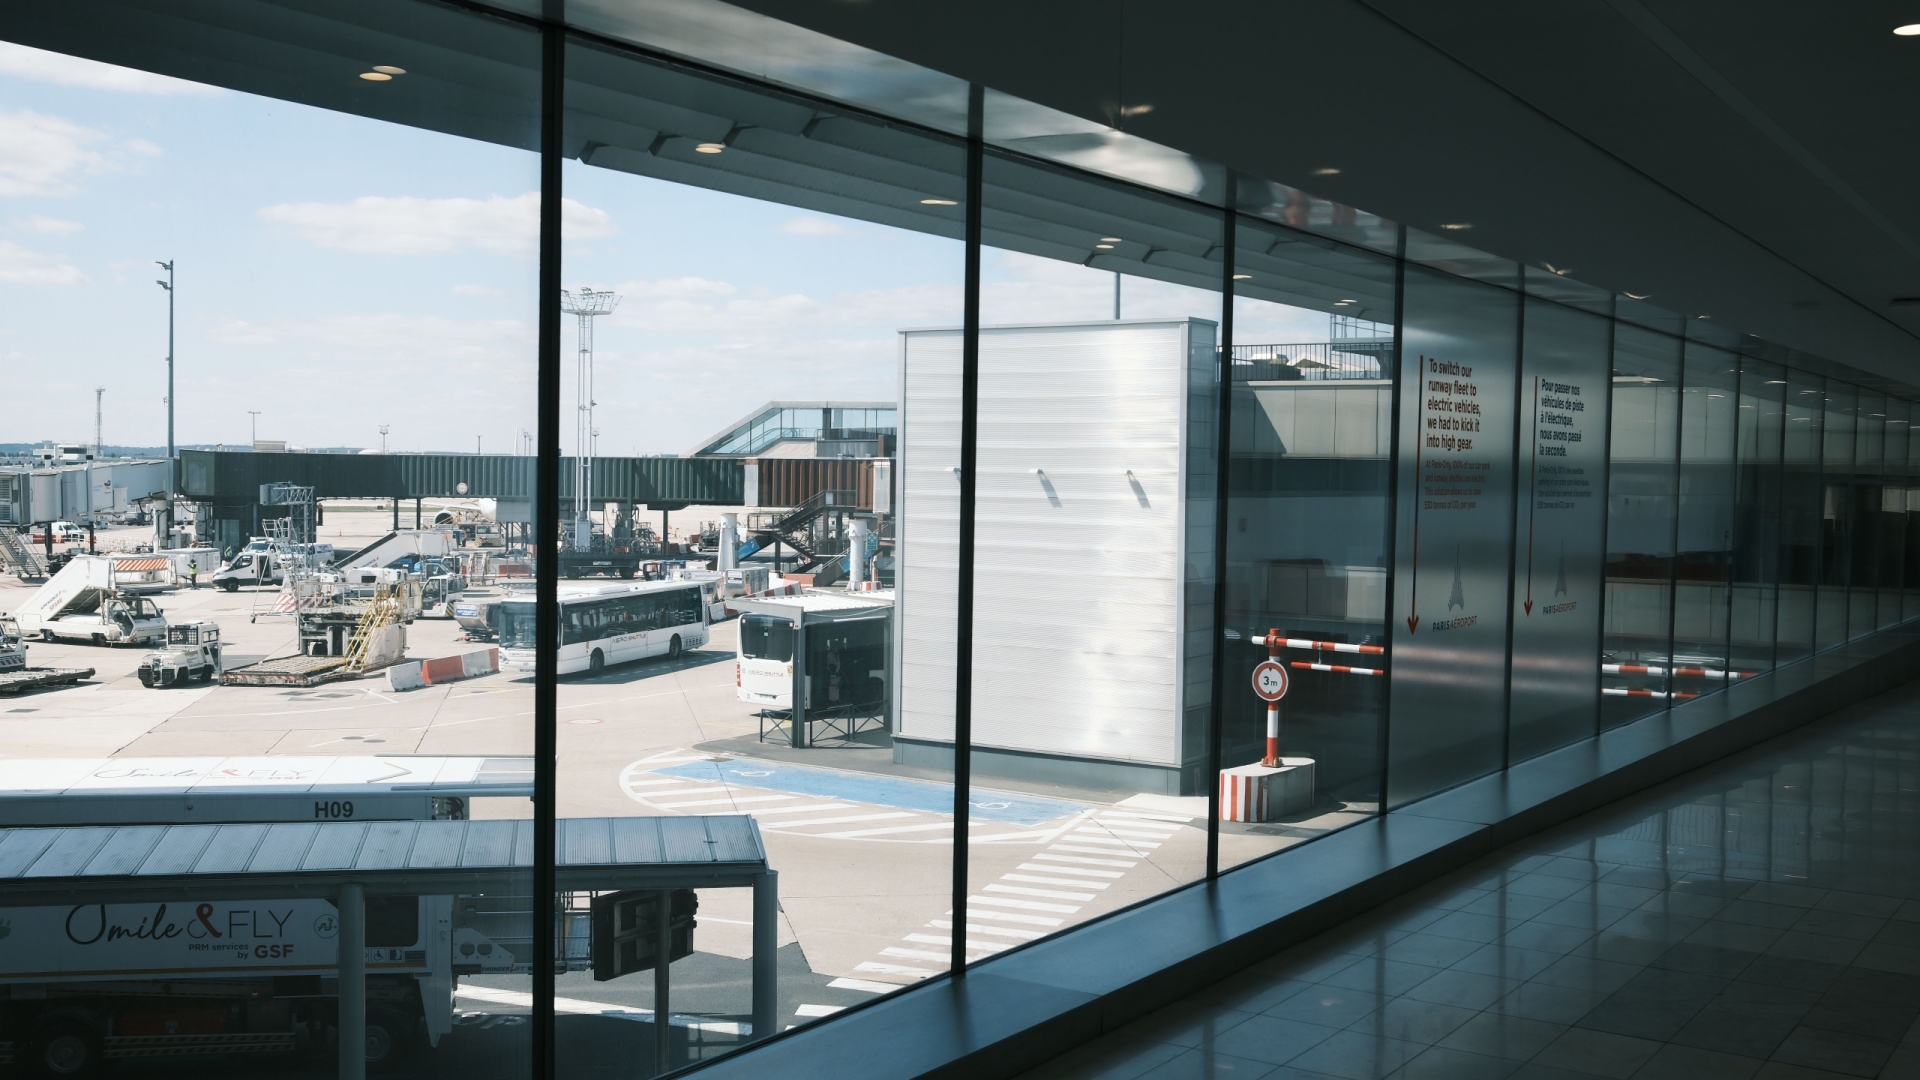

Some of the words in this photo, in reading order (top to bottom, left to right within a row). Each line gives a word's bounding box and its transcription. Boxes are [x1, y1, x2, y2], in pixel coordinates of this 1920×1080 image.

[1429, 358, 1438, 373] To
[1439, 360, 1460, 376] switch
[1461, 366, 1472, 378] our
[1428, 380, 1452, 396] runway
[1454, 380, 1468, 396] fleet
[1470, 383, 1476, 396] to
[1542, 378, 1554, 392] Pour
[1555, 383, 1570, 395] passer
[1571, 386, 1580, 396] nos
[1428, 396, 1452, 412] electric
[1454, 399, 1480, 417] vehicles,
[1541, 394, 1564, 409] véhicules
[1565, 398, 1571, 410] de
[1572, 399, 1584, 413] piste
[1427, 417, 1437, 429] we
[1438, 415, 1451, 430] had
[1452, 417, 1459, 431] to
[1461, 417, 1474, 432] kick
[1475, 418, 1480, 432] it
[1540, 410, 1544, 423] à
[1426, 433, 1440, 448] into
[1441, 434, 1455, 451] high
[1457, 437, 1472, 452] gear.
[1540, 430, 1552, 440] nous
[1553, 430, 1567, 441] avons
[1568, 430, 1582, 444] passé
[1539, 443, 1544, 456] la
[1545, 445, 1567, 457] seconde.
[1482, 462, 1490, 471] park
[315, 801, 354, 818] H09
[188, 903, 223, 939] &
[229, 910, 293, 939] FLY
[238, 951, 249, 959] by
[254, 944, 294, 959] GSF
